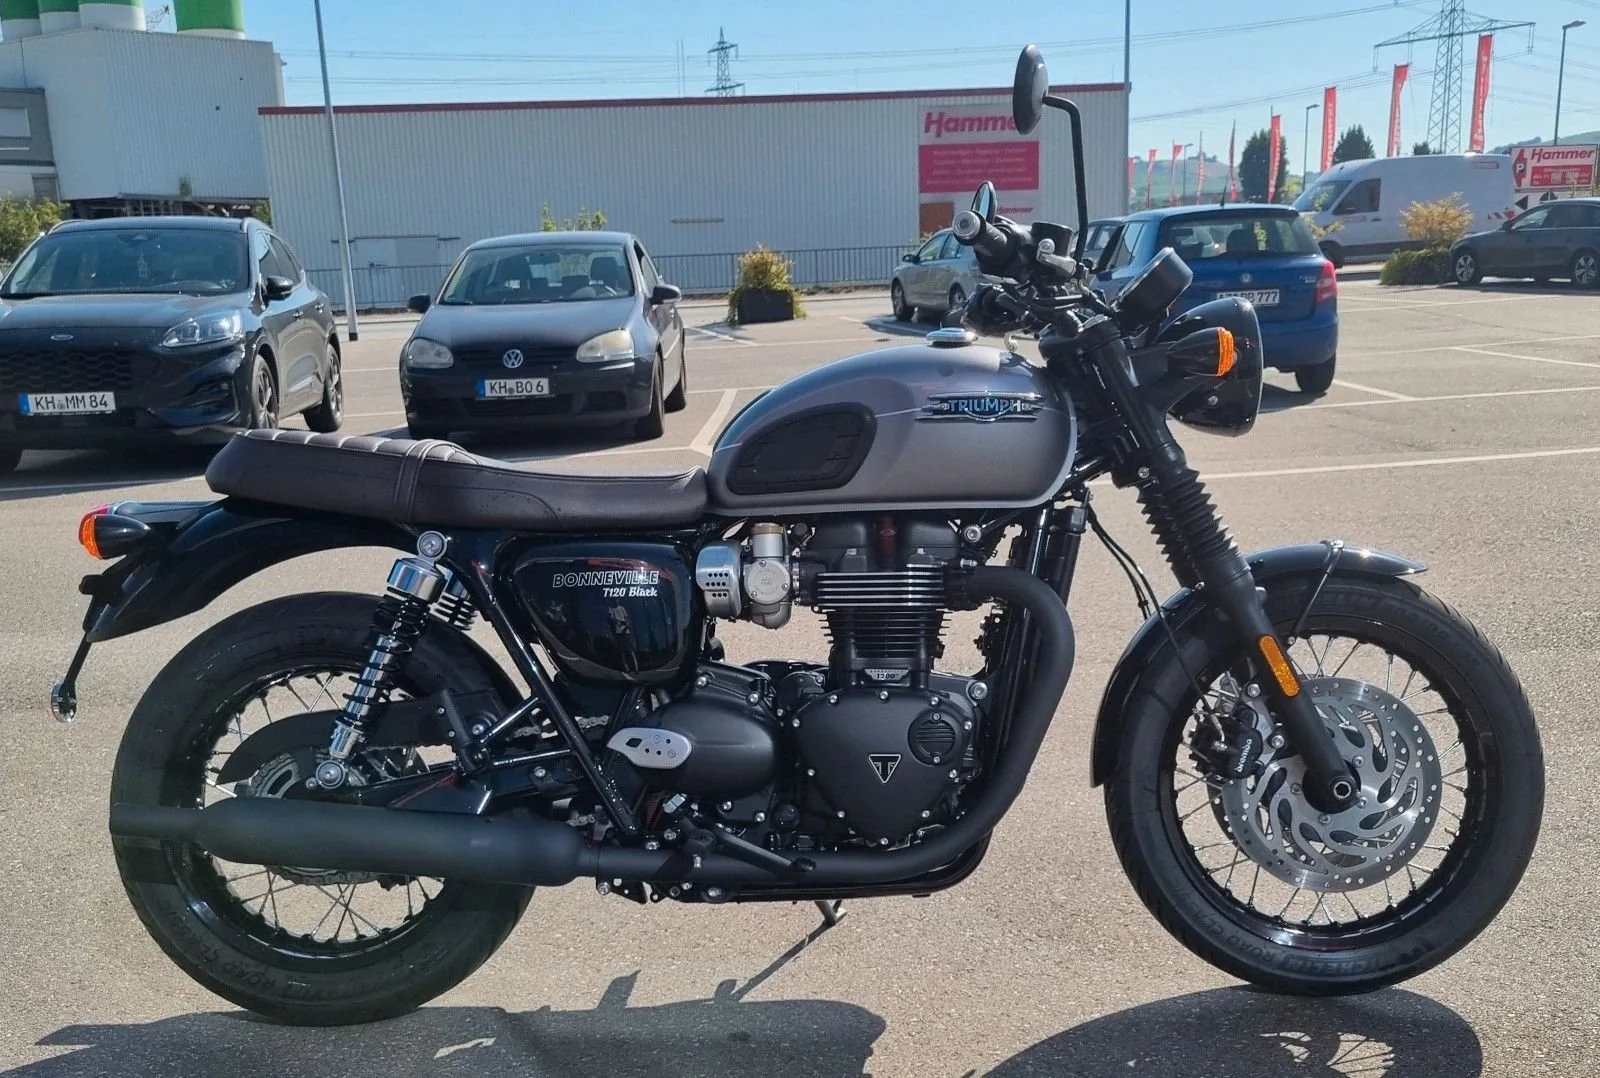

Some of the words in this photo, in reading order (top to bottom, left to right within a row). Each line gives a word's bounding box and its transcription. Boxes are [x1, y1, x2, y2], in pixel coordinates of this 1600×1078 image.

[1530, 148, 1594, 163] Hammer
[1257, 291, 1278, 302] 777
[490, 382, 507, 394] KH
[536, 380, 544, 393] 6
[34, 396, 56, 410] KH
[65, 395, 87, 409] MM
[89, 394, 108, 408] 84
[948, 398, 1021, 412] TRIUMPH
[552, 570, 659, 588] BONNEVILLE
[603, 587, 626, 598] T120
[629, 586, 658, 597] Black
